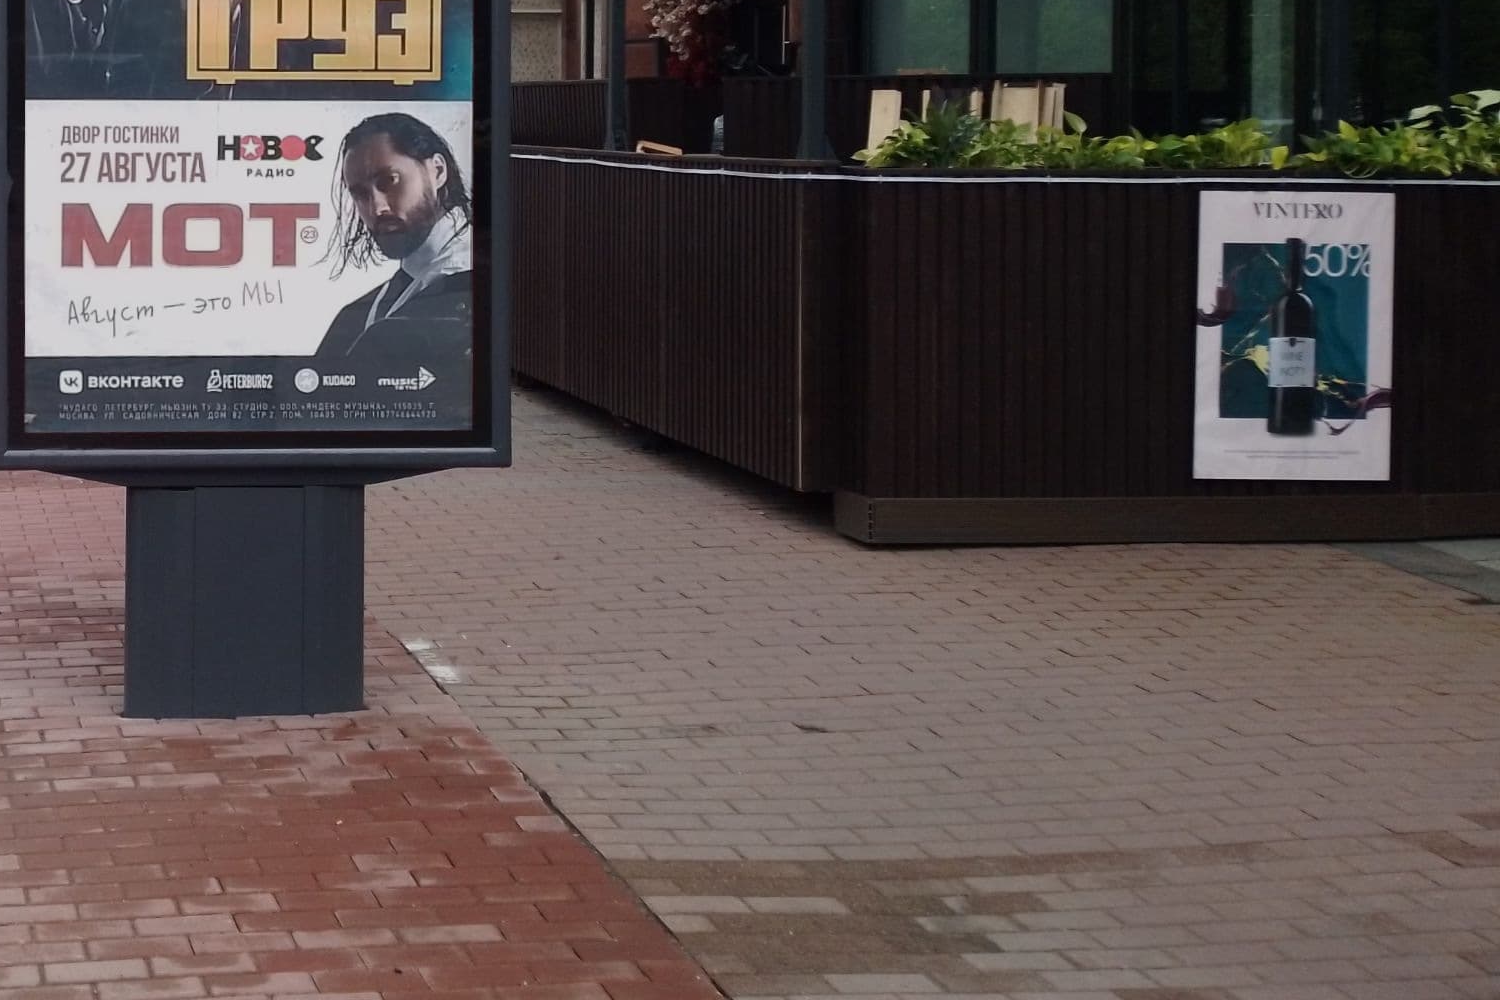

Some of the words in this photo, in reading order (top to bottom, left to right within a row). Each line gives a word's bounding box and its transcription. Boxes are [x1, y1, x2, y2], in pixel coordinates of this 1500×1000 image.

[60, 125, 100, 146] ДВОР
[104, 125, 180, 145] ГОСТИНКИ
[60, 152, 90, 184] 27
[97, 152, 206, 184] АВГУСТА
[246, 168, 296, 179] РАДИО
[60, 202, 321, 269] МОТ
[67, 297, 155, 337] Август
[192, 296, 232, 315] это
[242, 280, 284, 307] МЫ
[87, 374, 185, 389] вконтакте
[378, 377, 419, 387] music
